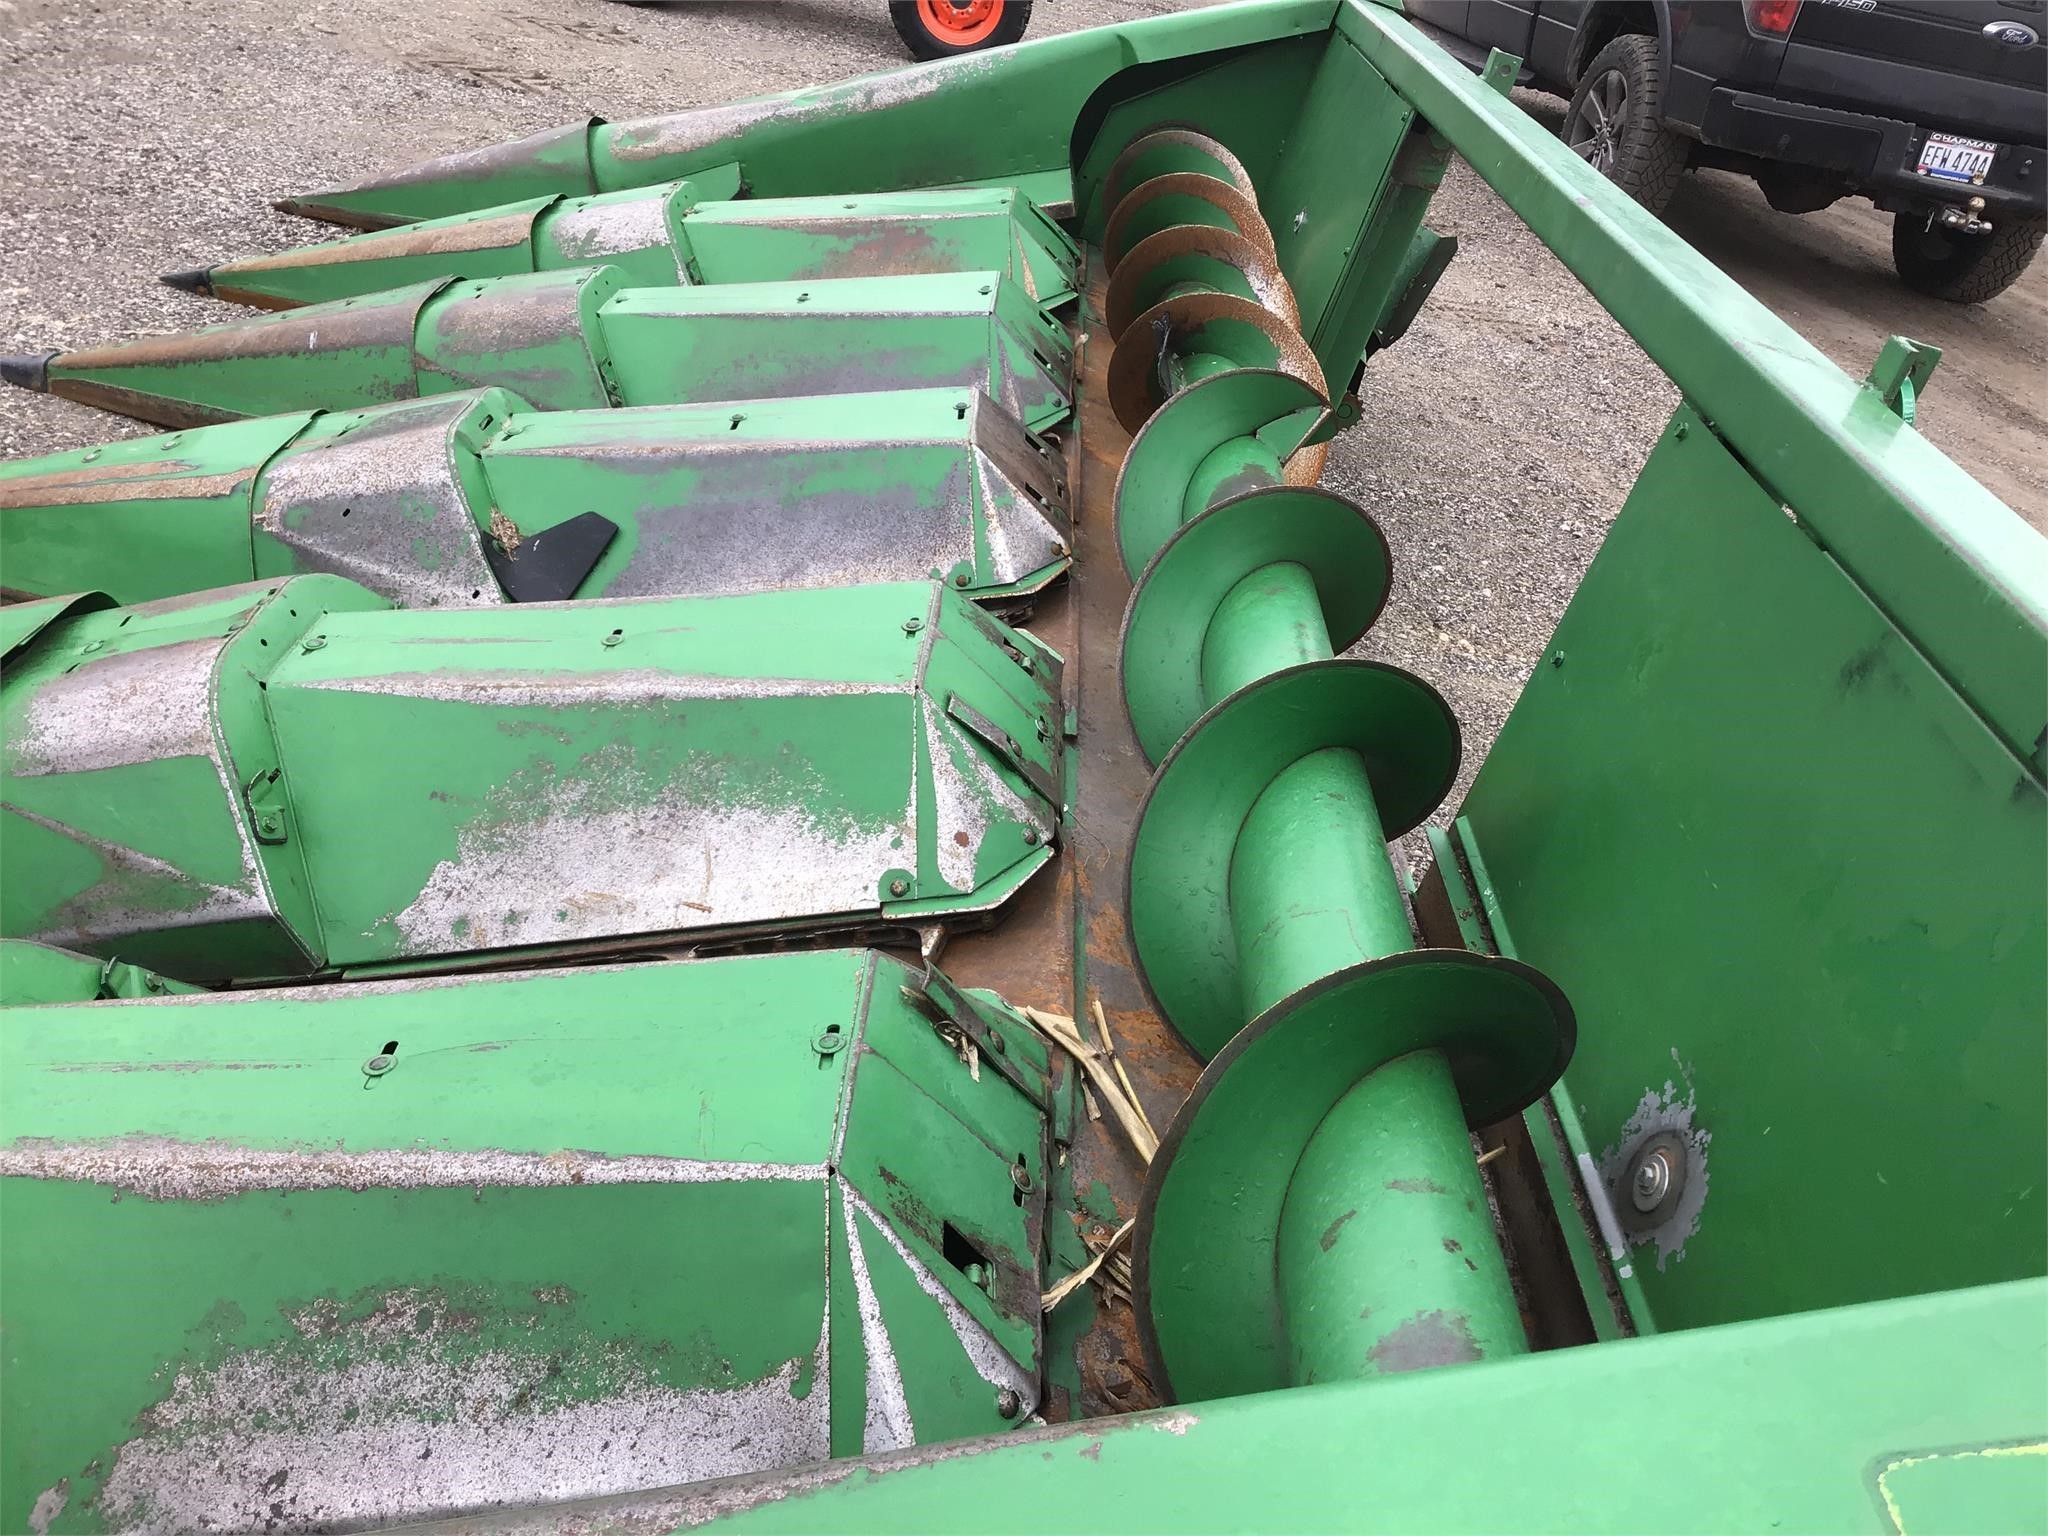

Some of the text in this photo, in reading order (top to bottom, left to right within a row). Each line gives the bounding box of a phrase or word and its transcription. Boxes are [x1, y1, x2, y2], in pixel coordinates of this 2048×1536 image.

[2002, 29, 2028, 43] Ford
[1932, 133, 1996, 151] CHAPMAN
[1922, 145, 1990, 174] EFW 4744
